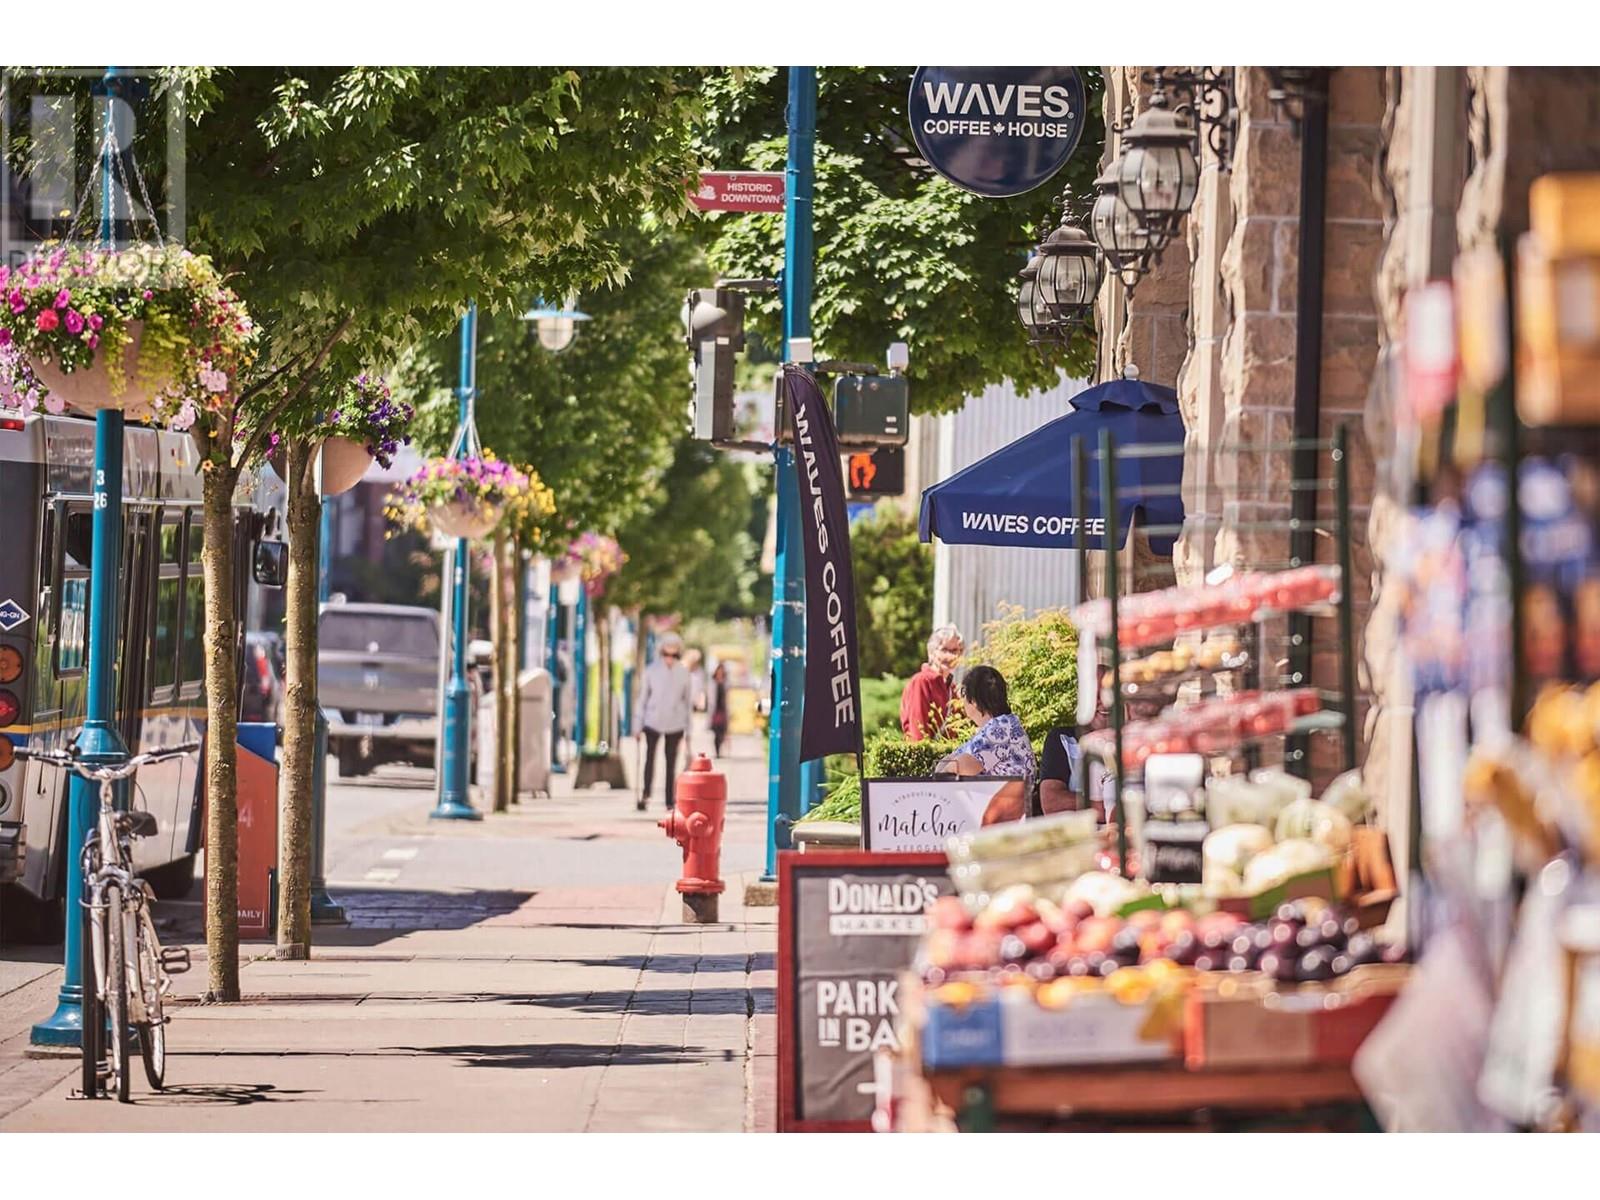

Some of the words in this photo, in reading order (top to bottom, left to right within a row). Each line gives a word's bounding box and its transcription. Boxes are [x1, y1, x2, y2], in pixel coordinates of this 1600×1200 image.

[923, 119, 991, 135] COFFEE
[1008, 122, 1068, 138] HOUSE
[727, 183, 773, 192] HISTORIC
[721, 193, 780, 204] DOWNTOWN
[96, 469, 105, 486] 3
[962, 512, 1029, 534] WAVES
[822, 561, 855, 729] COFFEE
[838, 918, 927, 931] MARKE
[818, 1017, 841, 1047] IN
[846, 1018, 902, 1052] BA
